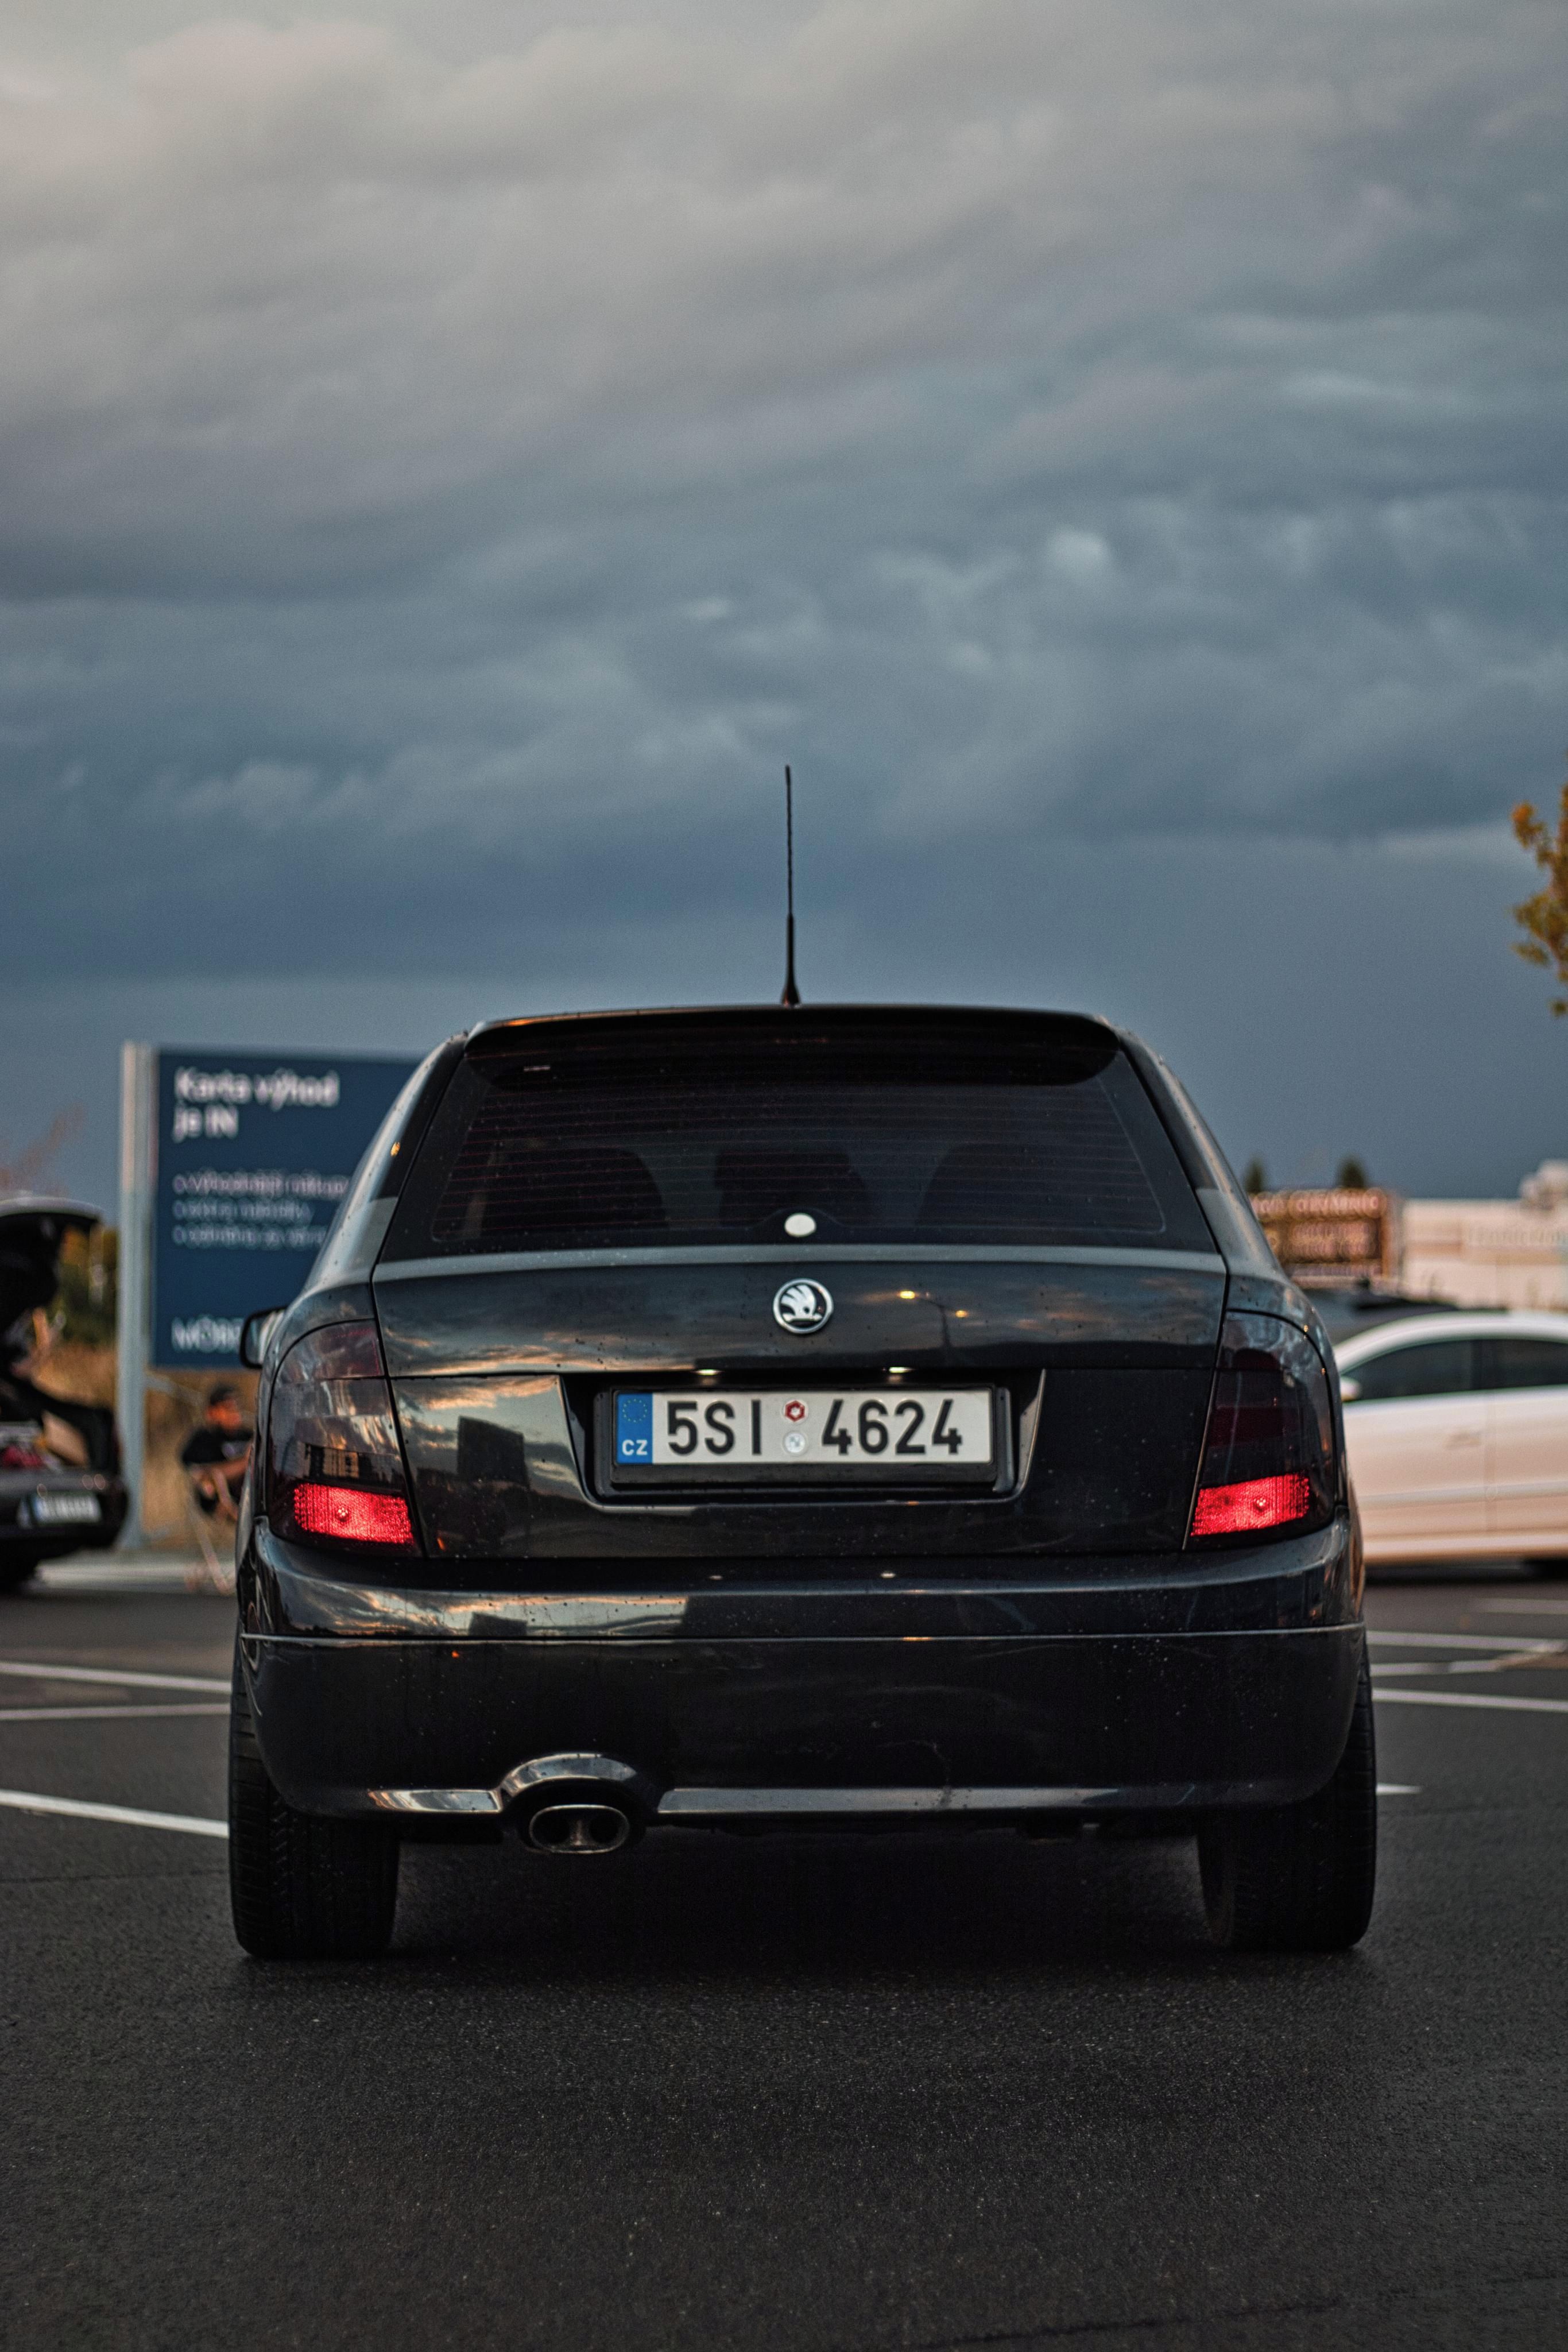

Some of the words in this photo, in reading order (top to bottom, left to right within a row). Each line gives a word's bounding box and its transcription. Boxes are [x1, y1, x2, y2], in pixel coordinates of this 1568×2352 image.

[667, 1399, 762, 1456] 5SI
[822, 1399, 962, 1456] 4624
[622, 1441, 648, 1456] CZ
